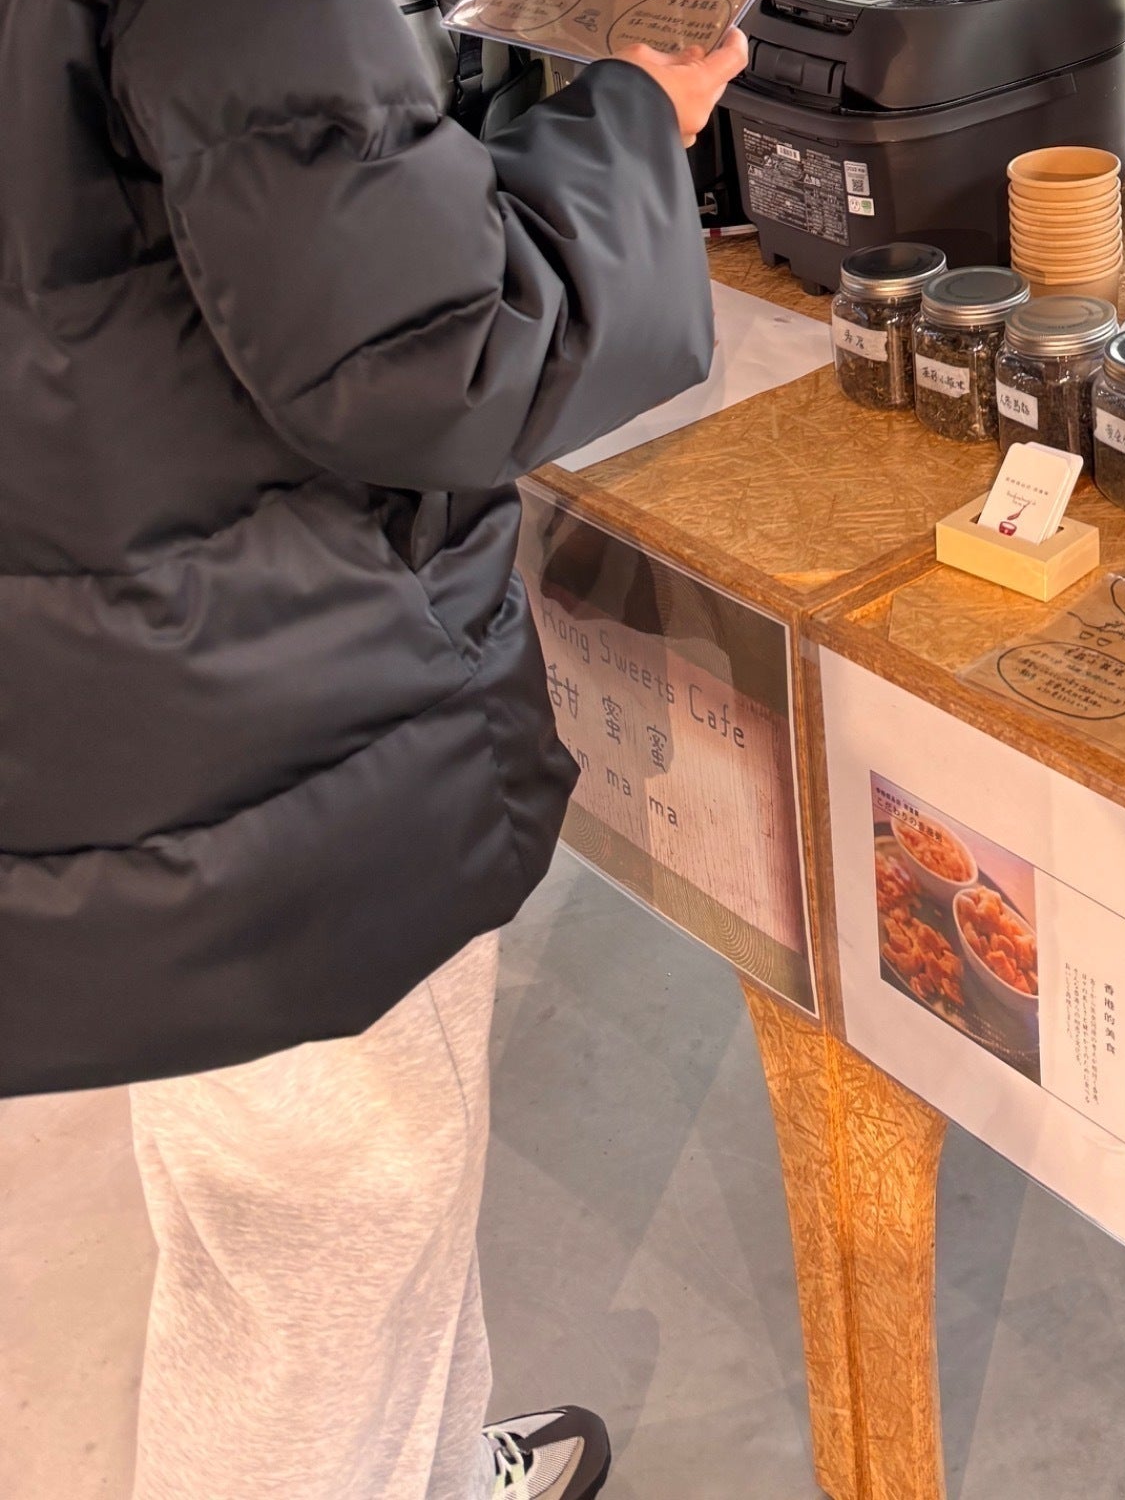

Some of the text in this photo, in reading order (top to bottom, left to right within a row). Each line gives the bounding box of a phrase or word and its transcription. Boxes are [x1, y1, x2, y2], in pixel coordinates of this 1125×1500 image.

[599, 629, 676, 705] Sweets
[688, 683, 745, 750] Cafe
[606, 767, 679, 828] ma ma
